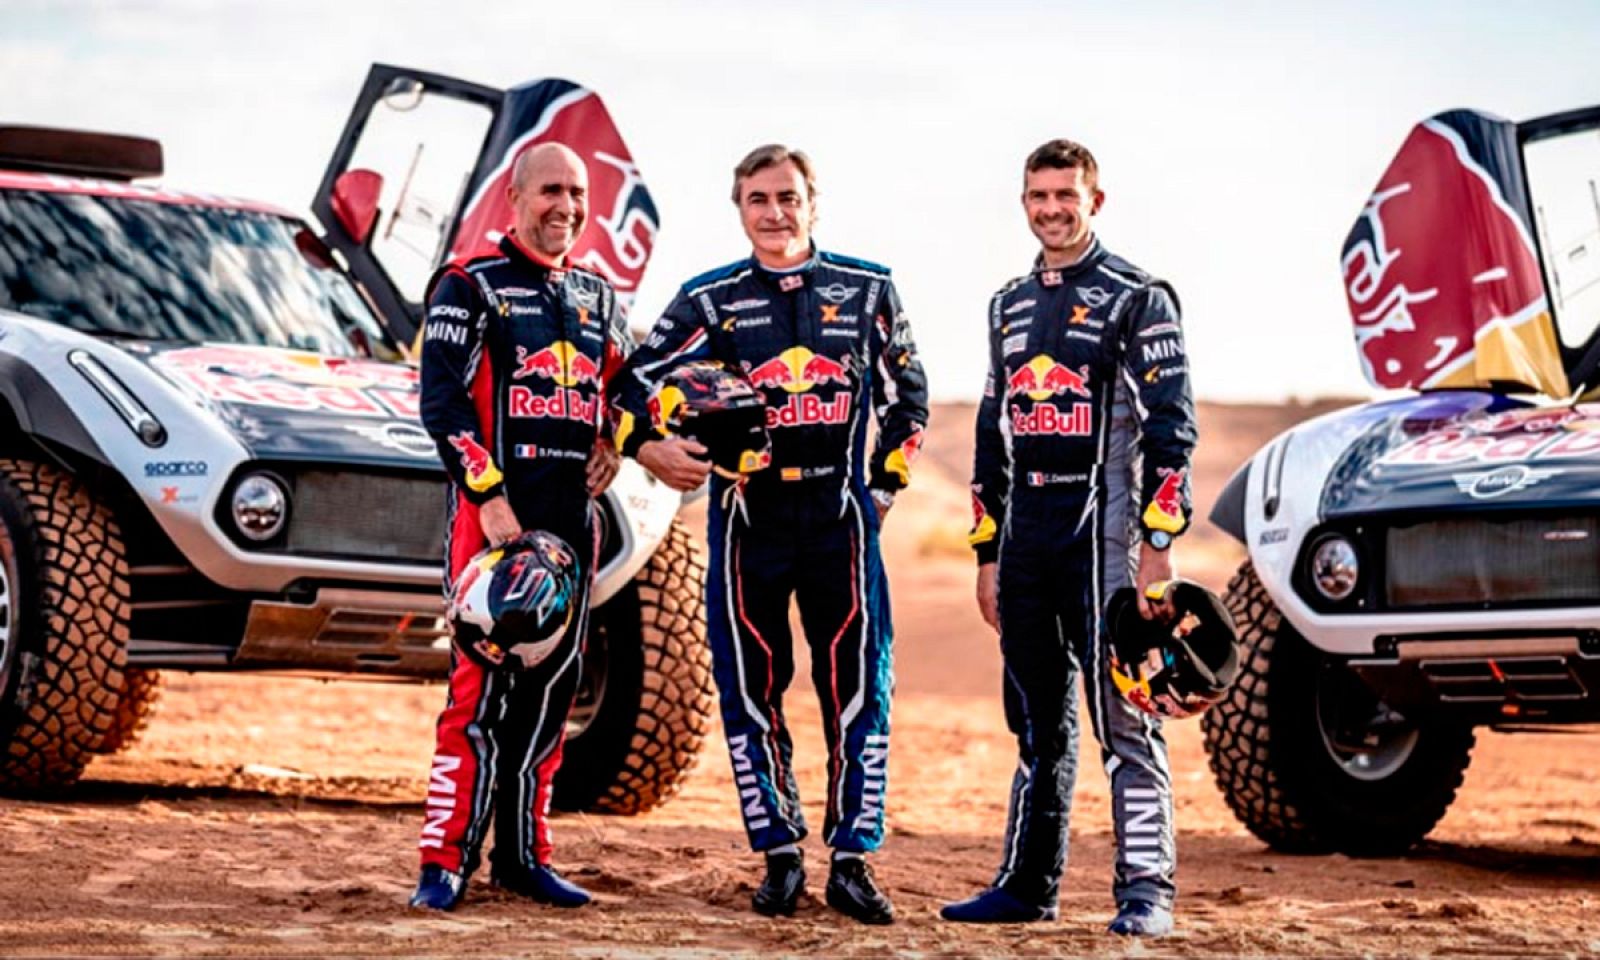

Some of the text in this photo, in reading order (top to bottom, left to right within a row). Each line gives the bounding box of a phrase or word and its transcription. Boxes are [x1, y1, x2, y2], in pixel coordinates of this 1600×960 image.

[426, 321, 468, 345] MINI
[1143, 339, 1184, 362] MIN
[509, 386, 598, 426] Red Bul
[764, 391, 852, 428] ed Bull
[1040, 402, 1092, 436] Bull
[419, 755, 461, 848] MINI
[729, 734, 771, 830] MINI
[855, 735, 889, 829] MINI
[1124, 788, 1161, 882] MINI
